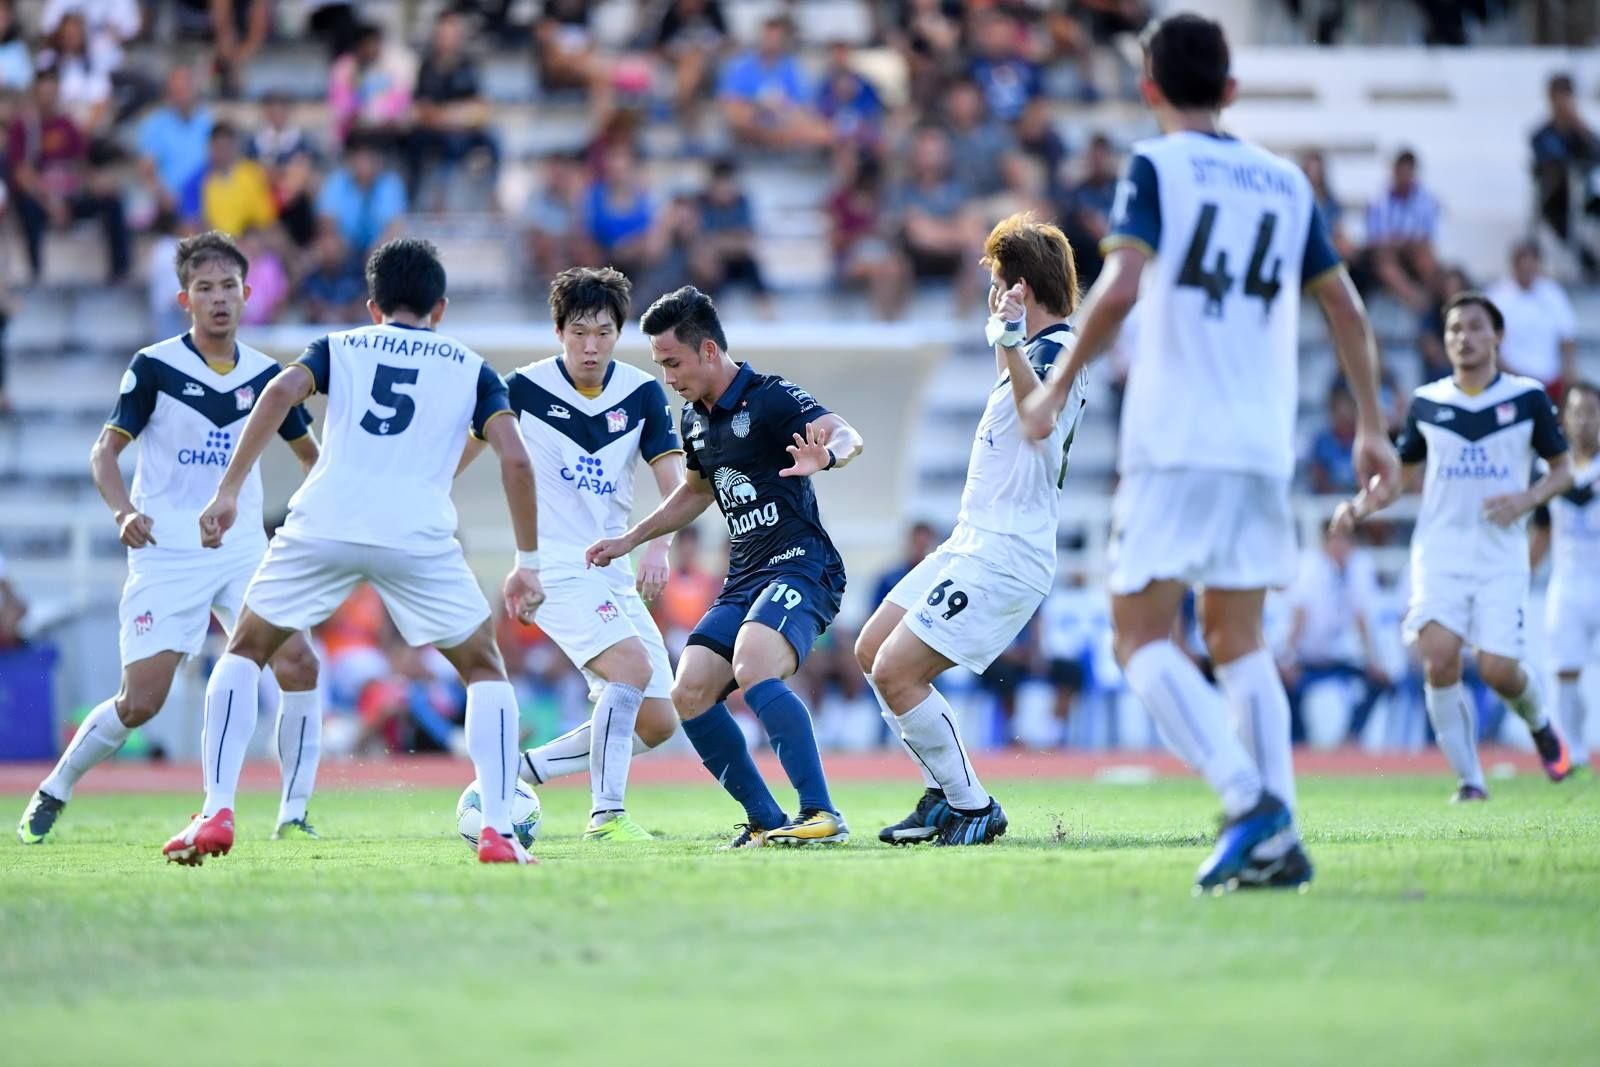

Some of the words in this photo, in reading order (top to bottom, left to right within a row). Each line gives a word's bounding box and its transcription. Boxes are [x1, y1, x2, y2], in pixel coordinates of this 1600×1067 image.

[1175, 203, 1285, 320] 44
[343, 335, 465, 364] NATHAPHON
[360, 363, 419, 436] 5
[178, 449, 232, 467] CHAB
[560, 467, 616, 496] CABA
[771, 583, 802, 610] 19
[927, 579, 969, 620] 69
